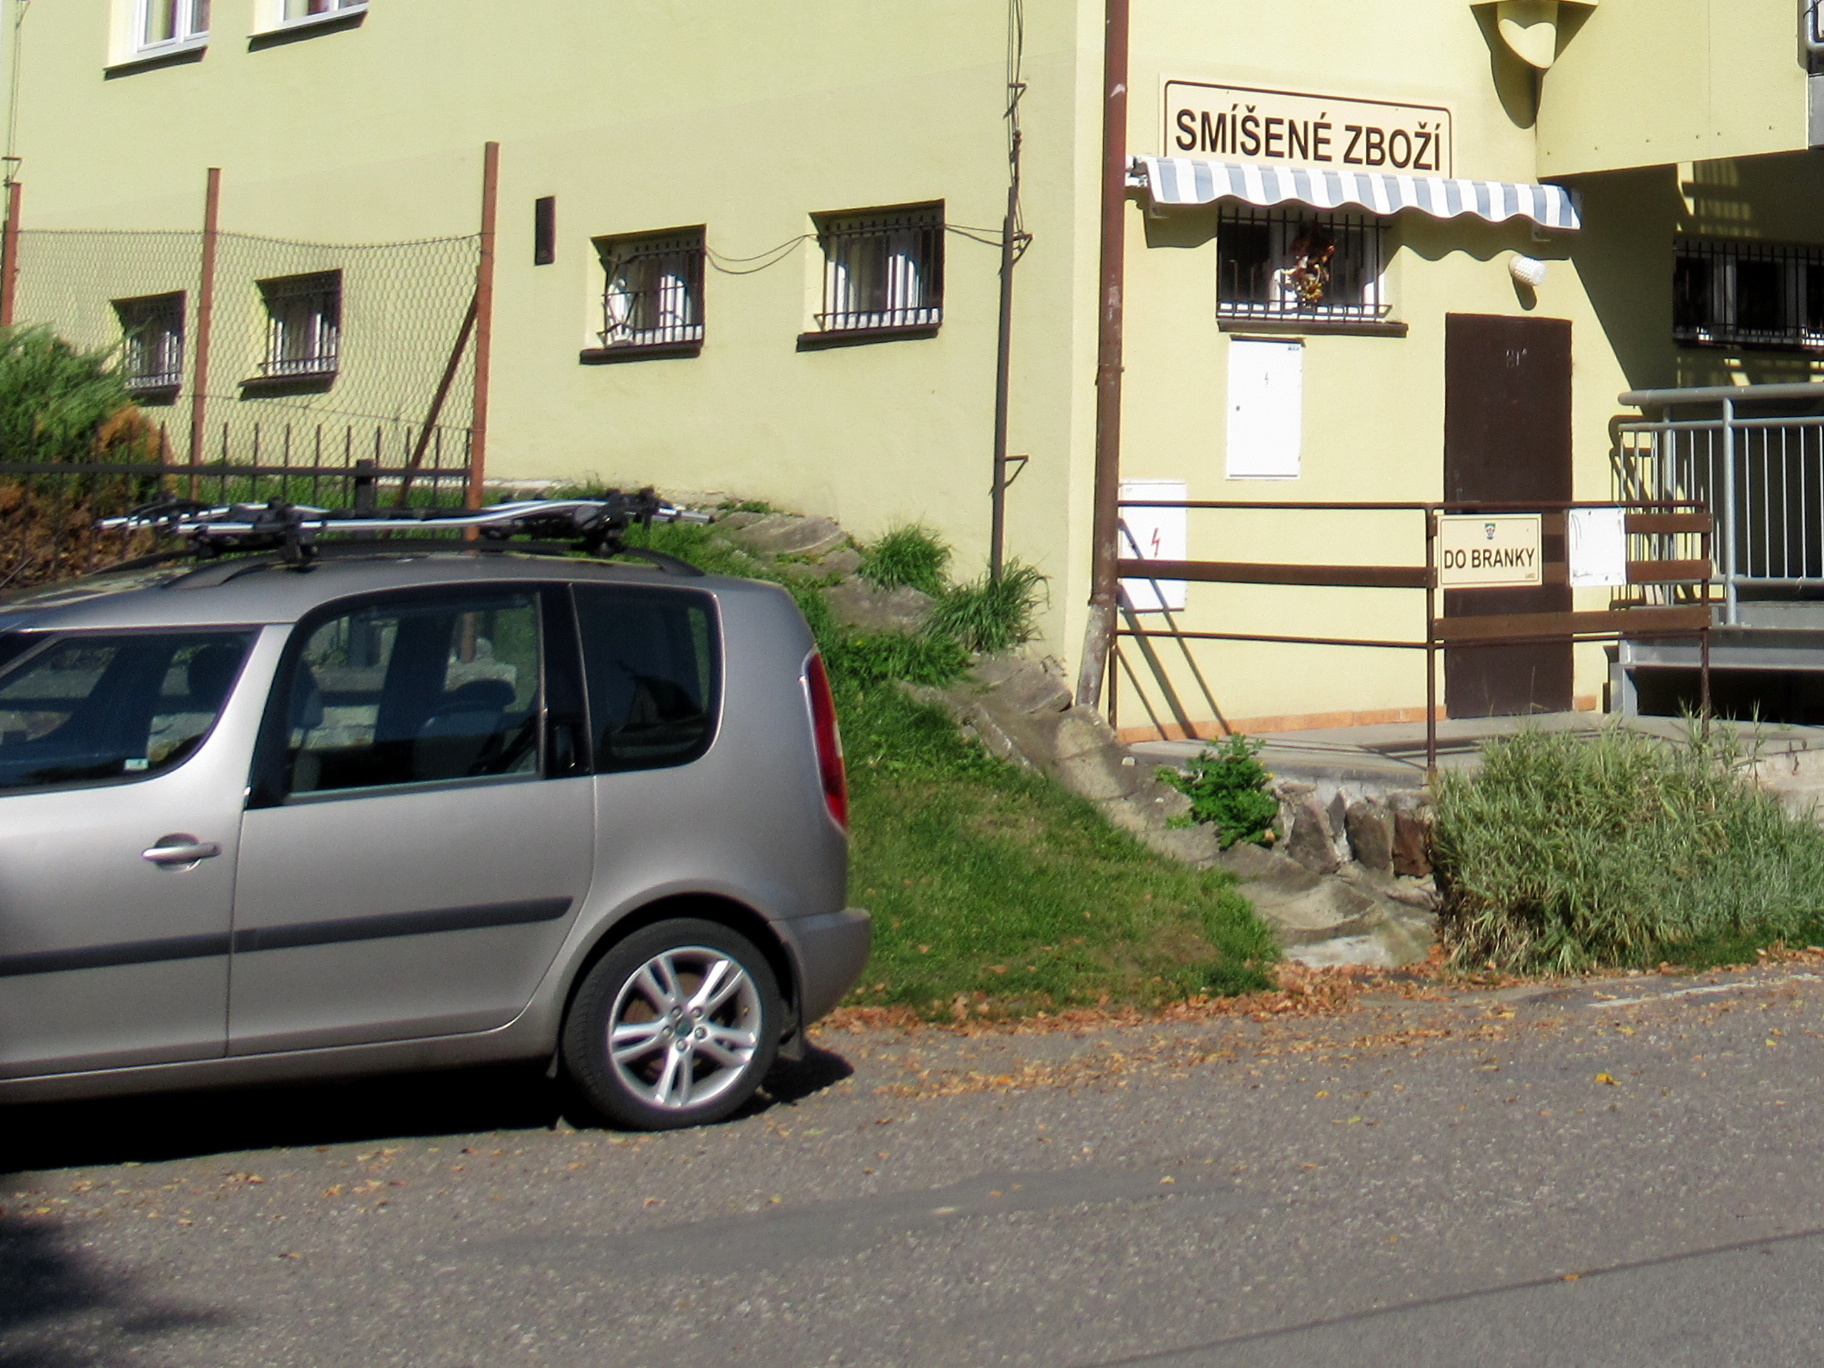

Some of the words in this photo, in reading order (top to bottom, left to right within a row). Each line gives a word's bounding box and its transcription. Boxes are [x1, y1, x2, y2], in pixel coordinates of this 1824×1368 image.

[1175, 103, 1333, 163] SMÍŠENÉ
[1343, 121, 1441, 171] ZBOŽÍ
[1444, 549, 1466, 569] DO
[1472, 548, 1535, 568] BRANKY
